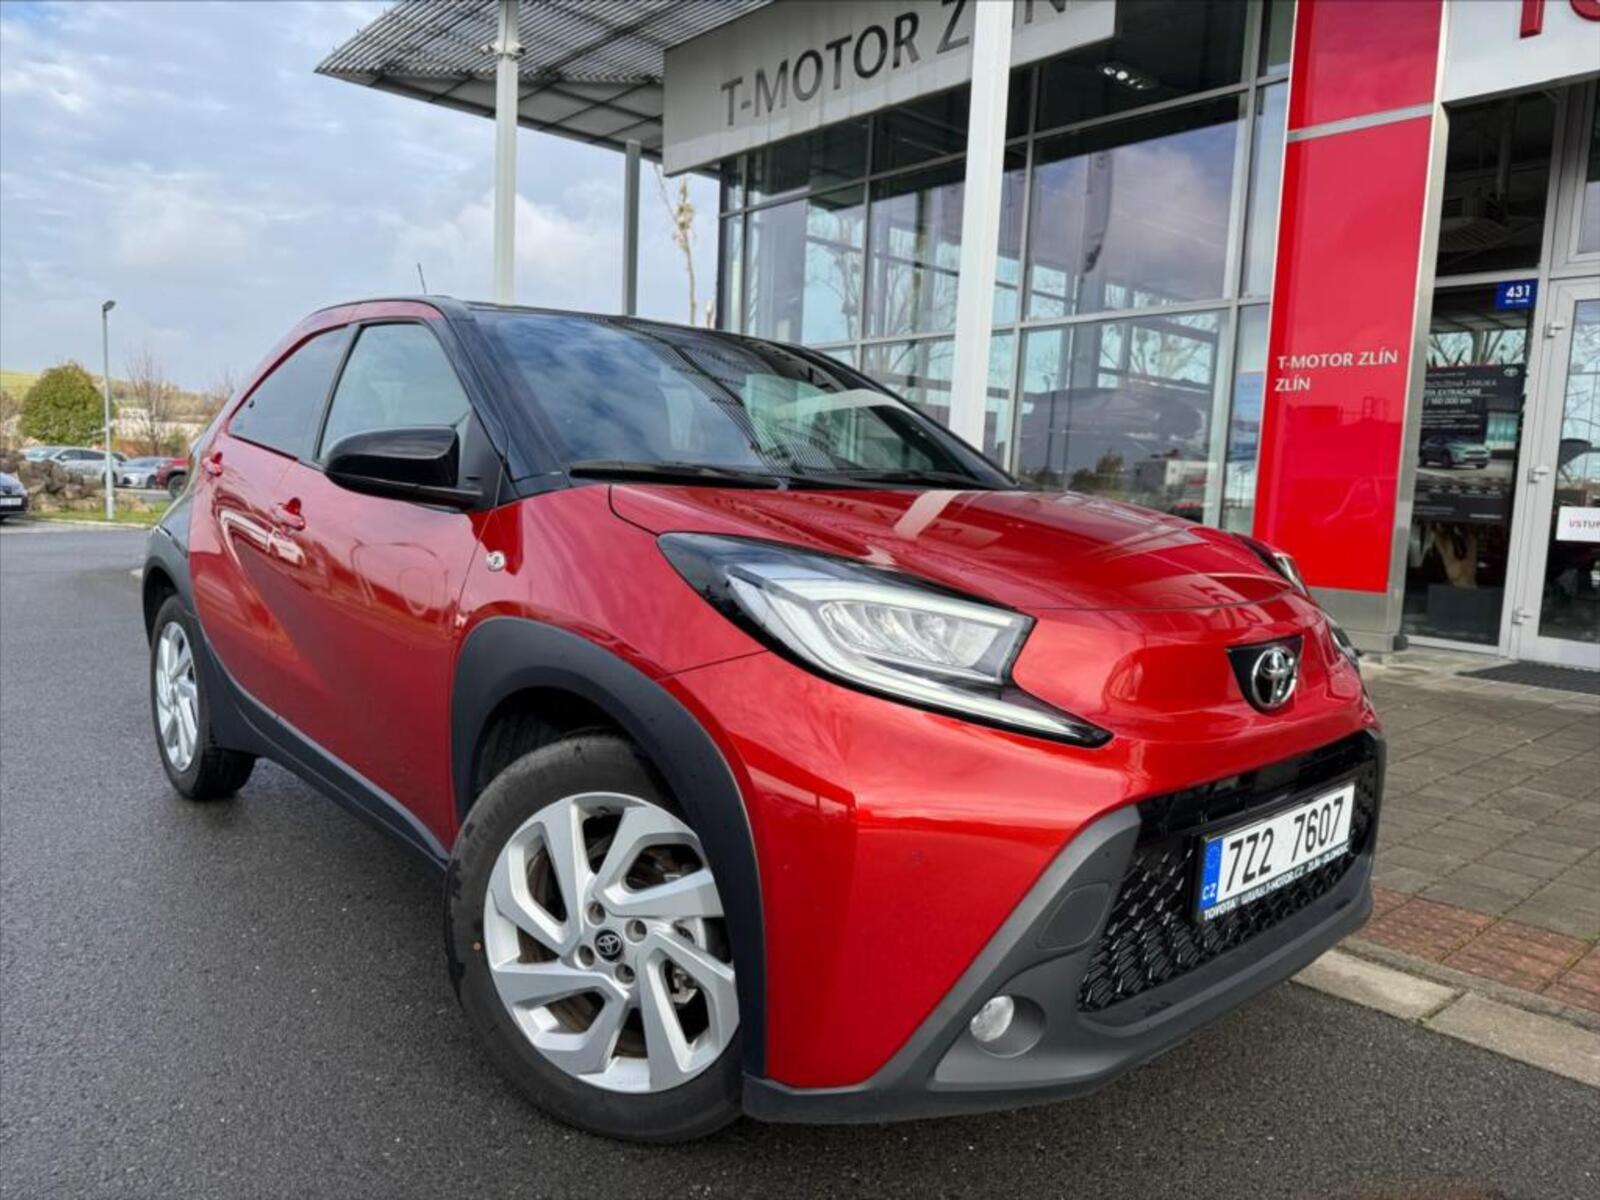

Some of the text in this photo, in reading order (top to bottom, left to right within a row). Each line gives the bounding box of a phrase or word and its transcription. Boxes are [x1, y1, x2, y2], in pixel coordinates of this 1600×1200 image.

[721, 11, 920, 126] T-MOTOR
[1505, 284, 1531, 298] 431
[1277, 347, 1398, 369] T-MOTOR ZLÍN
[1274, 374, 1311, 392] ZLÍN
[1202, 796, 1344, 900] CZ 7Z2 7607
